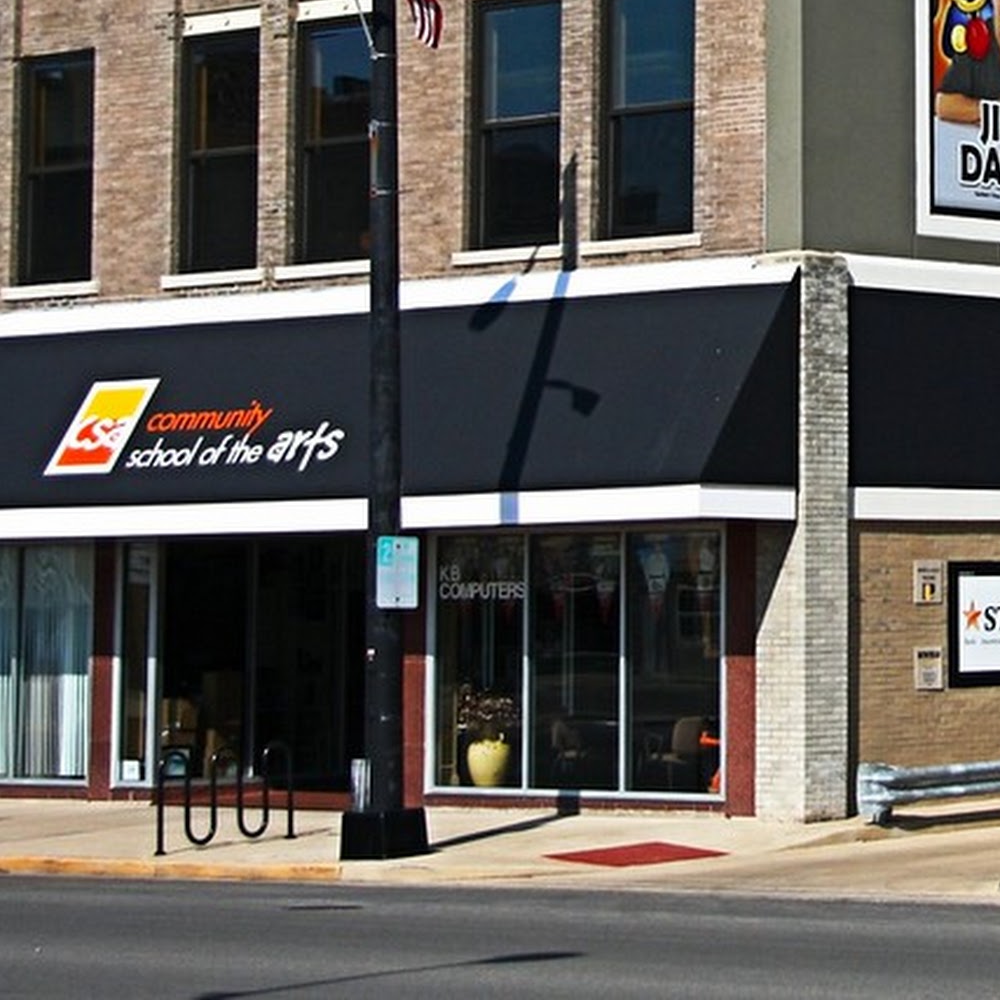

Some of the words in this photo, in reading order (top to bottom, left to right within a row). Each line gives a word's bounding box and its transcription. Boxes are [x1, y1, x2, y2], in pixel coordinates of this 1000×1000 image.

[147, 400, 273, 436] community
[125, 436, 203, 468] school
[199, 434, 234, 466] of
[226, 434, 263, 465] the
[266, 421, 345, 471] arts
[439, 582, 527, 599] COMPUTERS
